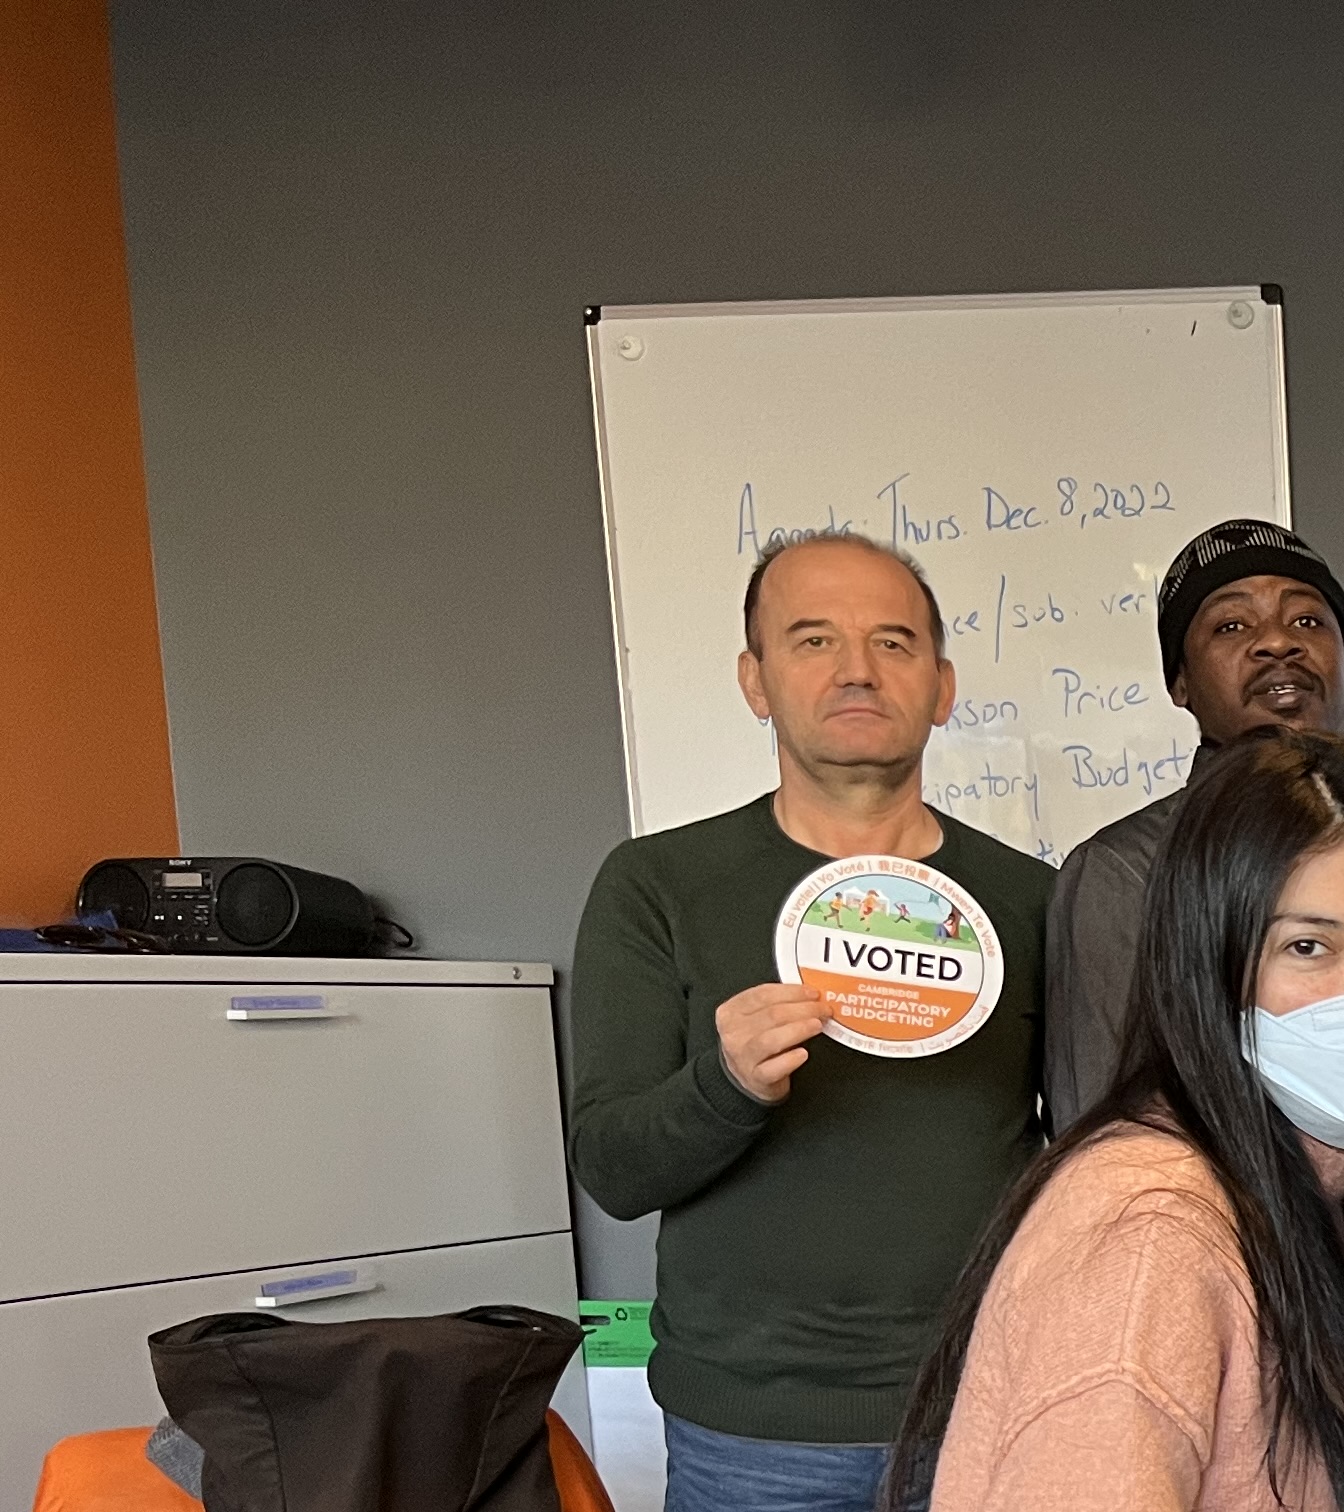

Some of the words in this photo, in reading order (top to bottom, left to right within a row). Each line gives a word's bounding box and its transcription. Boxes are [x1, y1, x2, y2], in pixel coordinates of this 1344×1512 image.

[982, 487, 1048, 530] Dec.
[945, 700, 1018, 731] kson
[1052, 668, 1150, 718] Price
[1062, 739, 1192, 796] Budget
[823, 937, 831, 963] I
[843, 940, 963, 982] VOTED
[826, 991, 951, 1018] PARTICIPATORY
[858, 984, 920, 1000] CAMBRIDGE
[841, 1005, 934, 1028] BUDGETING
